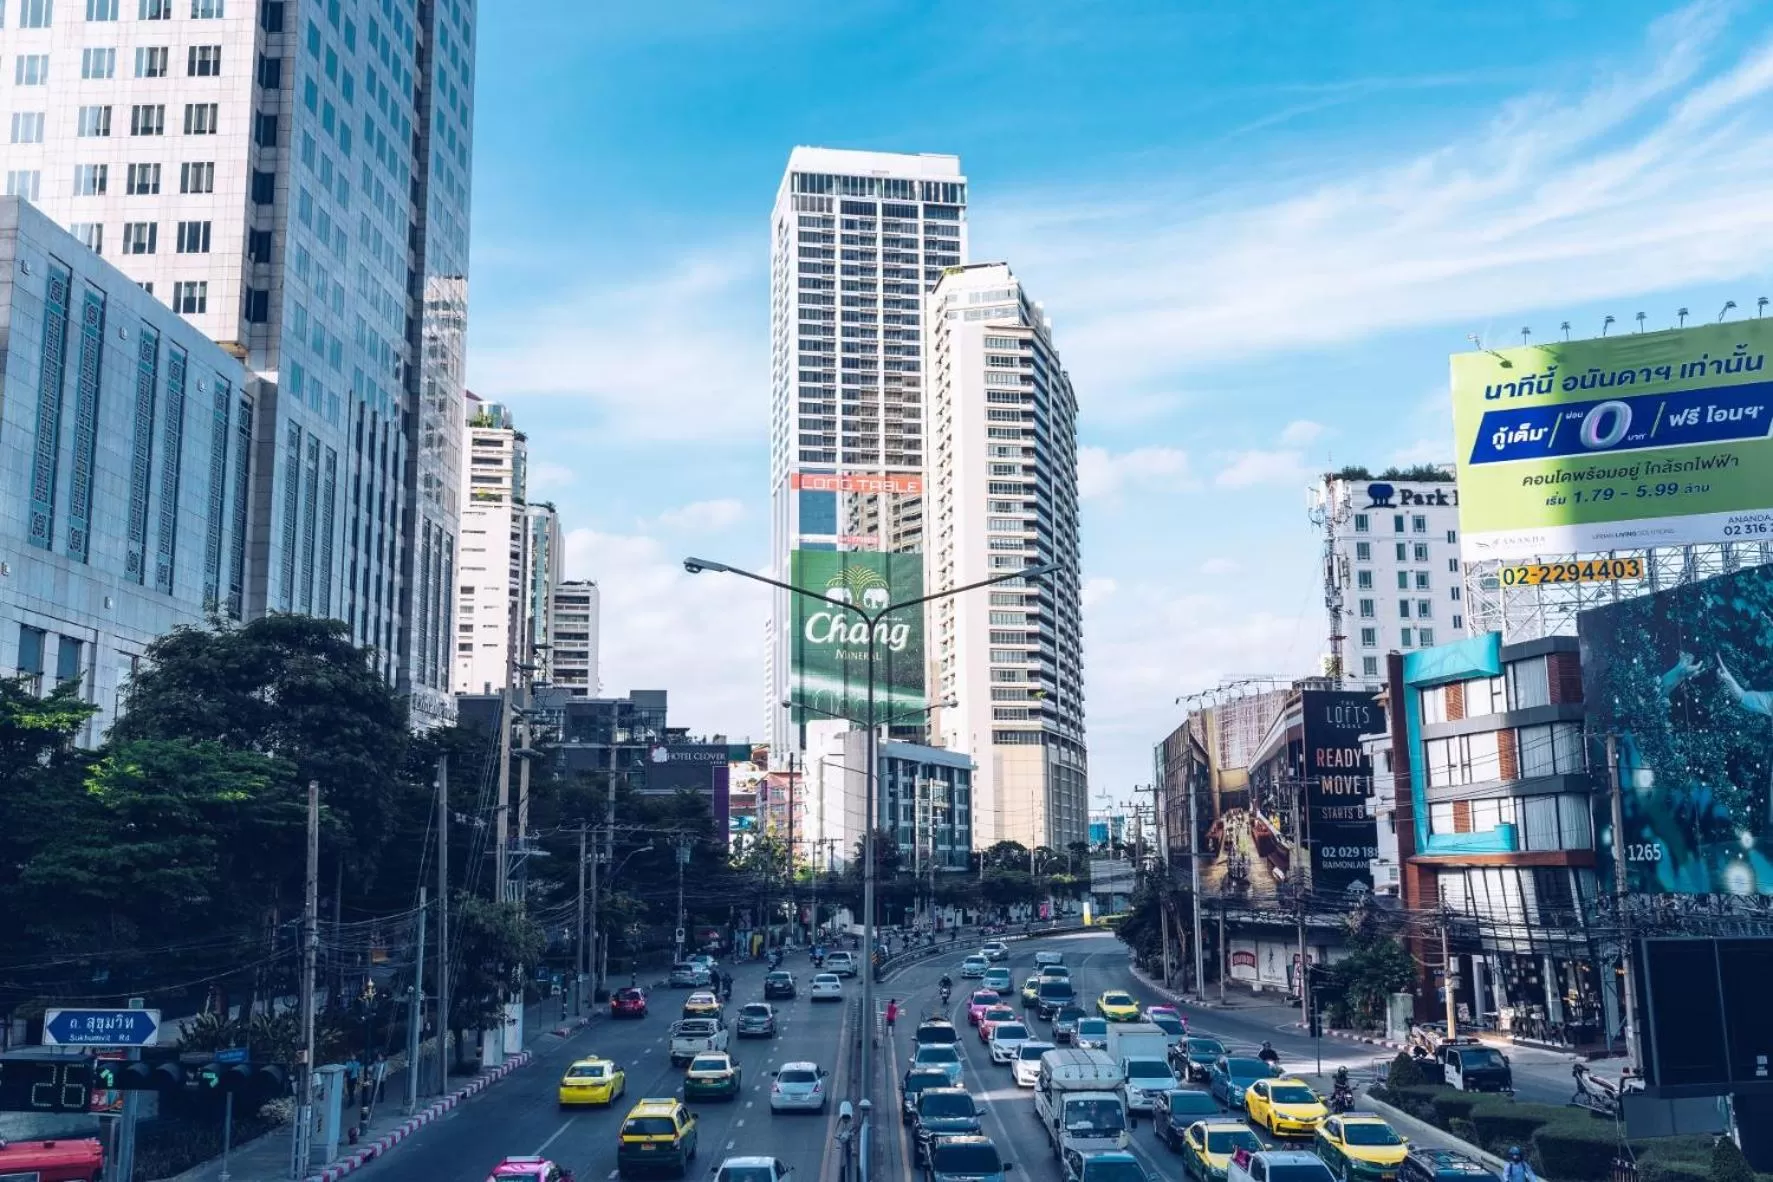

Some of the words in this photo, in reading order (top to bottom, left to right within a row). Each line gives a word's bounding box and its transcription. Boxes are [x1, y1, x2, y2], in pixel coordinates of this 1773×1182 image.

[1485, 365, 1558, 400] นาทีนี้
[1562, 365, 1671, 392] อนันดาฯ
[1680, 343, 1764, 379] เท่านั้น
[1580, 400, 1632, 450] 0
[1669, 406, 1701, 427] ฟรี
[1522, 461, 1641, 487] คอนโดพร้อมอยู่
[1645, 453, 1739, 476] ใกล้รถไฟฟ้า
[802, 477, 852, 490] LONG
[855, 479, 919, 493] TABLE
[1574, 487, 1614, 504] 1.79
[1636, 482, 1680, 499] 5.99
[1399, 488, 1450, 506] Park
[1723, 525, 1741, 536] 02
[1744, 523, 1767, 534] 316
[1502, 559, 1641, 586] 02-2294403
[805, 612, 911, 652] Chang
[835, 648, 881, 661] MINERL
[1326, 706, 1370, 724] LOFTS
[666, 752, 692, 761] HOTEL
[694, 752, 726, 761] CLOVER
[1316, 747, 1362, 768] READY
[1321, 775, 1362, 795] MOVE
[1322, 846, 1336, 858] 02
[1338, 846, 1360, 858] 029
[1628, 843, 1662, 861] 1265
[86, 1013, 134, 1033] สุขุมวิท
[69, 1033, 111, 1042] Sukhumvit
